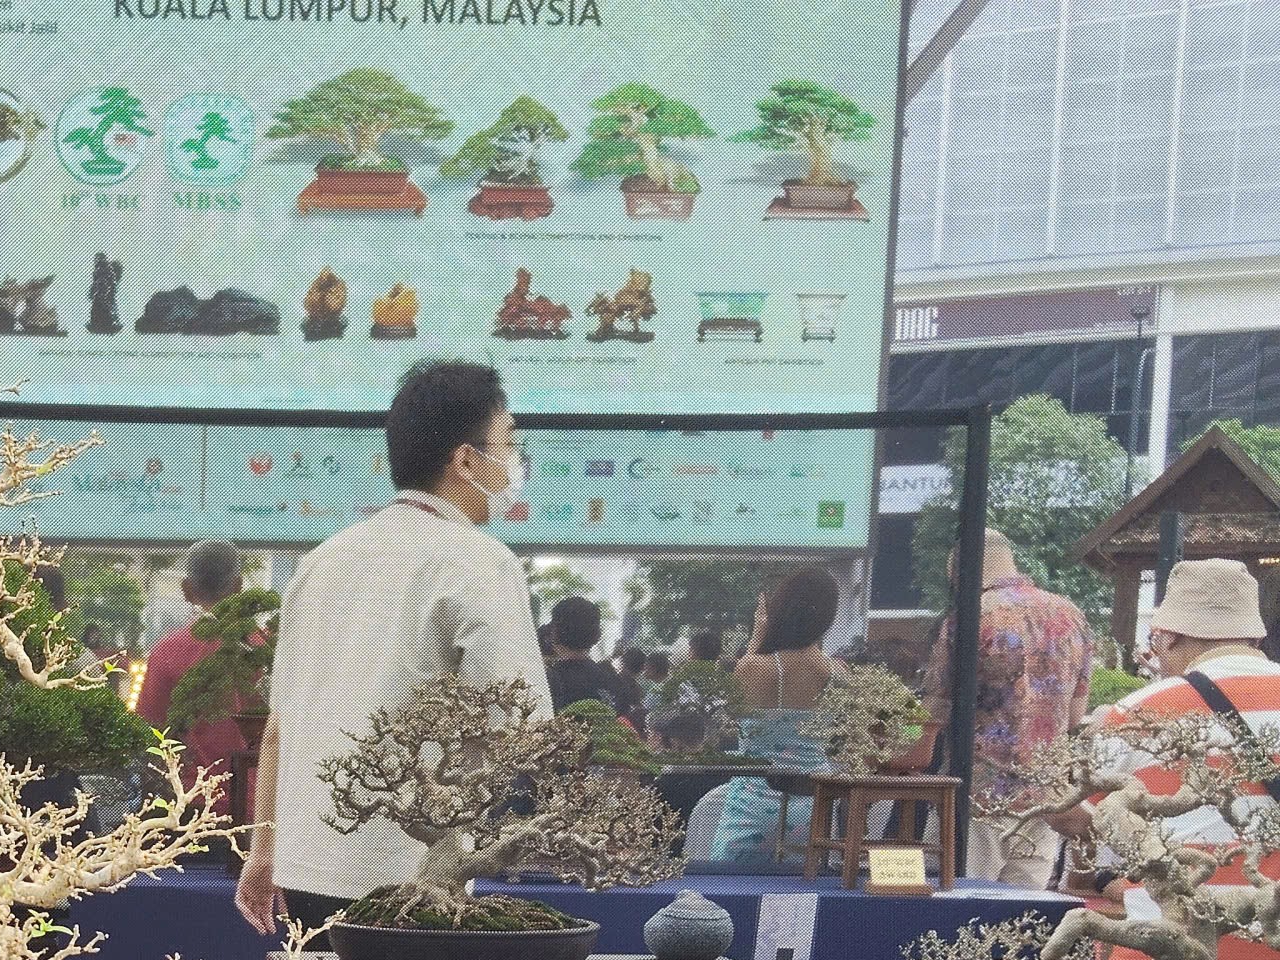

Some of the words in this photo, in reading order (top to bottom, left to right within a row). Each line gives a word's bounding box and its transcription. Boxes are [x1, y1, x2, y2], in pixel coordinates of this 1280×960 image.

[113, 0, 230, 20] KUALA
[242, 0, 410, 29] LUMPUR,
[421, 0, 604, 27] MALAYSIA
